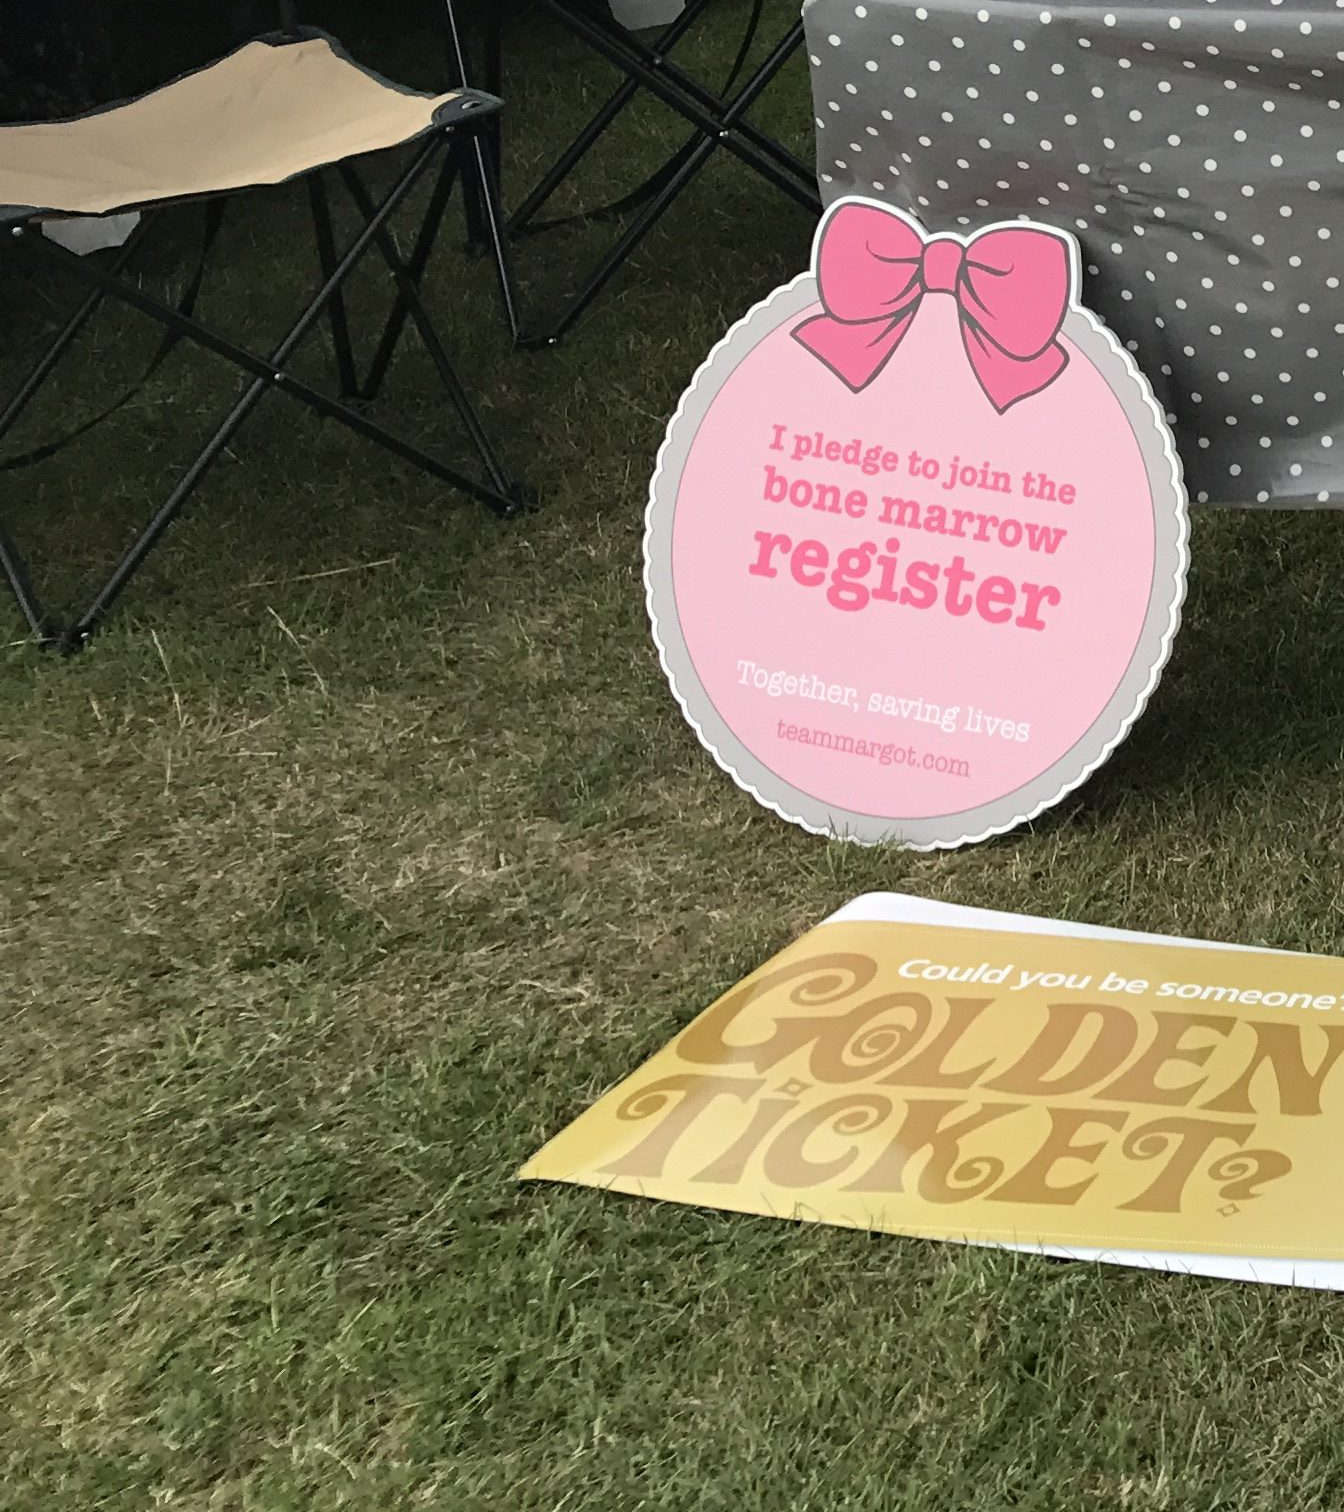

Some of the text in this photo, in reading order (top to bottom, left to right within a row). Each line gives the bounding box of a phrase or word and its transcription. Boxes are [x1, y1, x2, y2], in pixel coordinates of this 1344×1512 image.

[770, 425, 1077, 505] I pledge to join the
[763, 466, 1067, 555] bone marrow
[748, 529, 1061, 632] register
[736, 660, 1031, 743] Together, saving lives
[777, 718, 970, 778] teammargot.com
[898, 958, 1012, 986] Could
[1018, 968, 1092, 994] you
[1101, 971, 1148, 995] be
